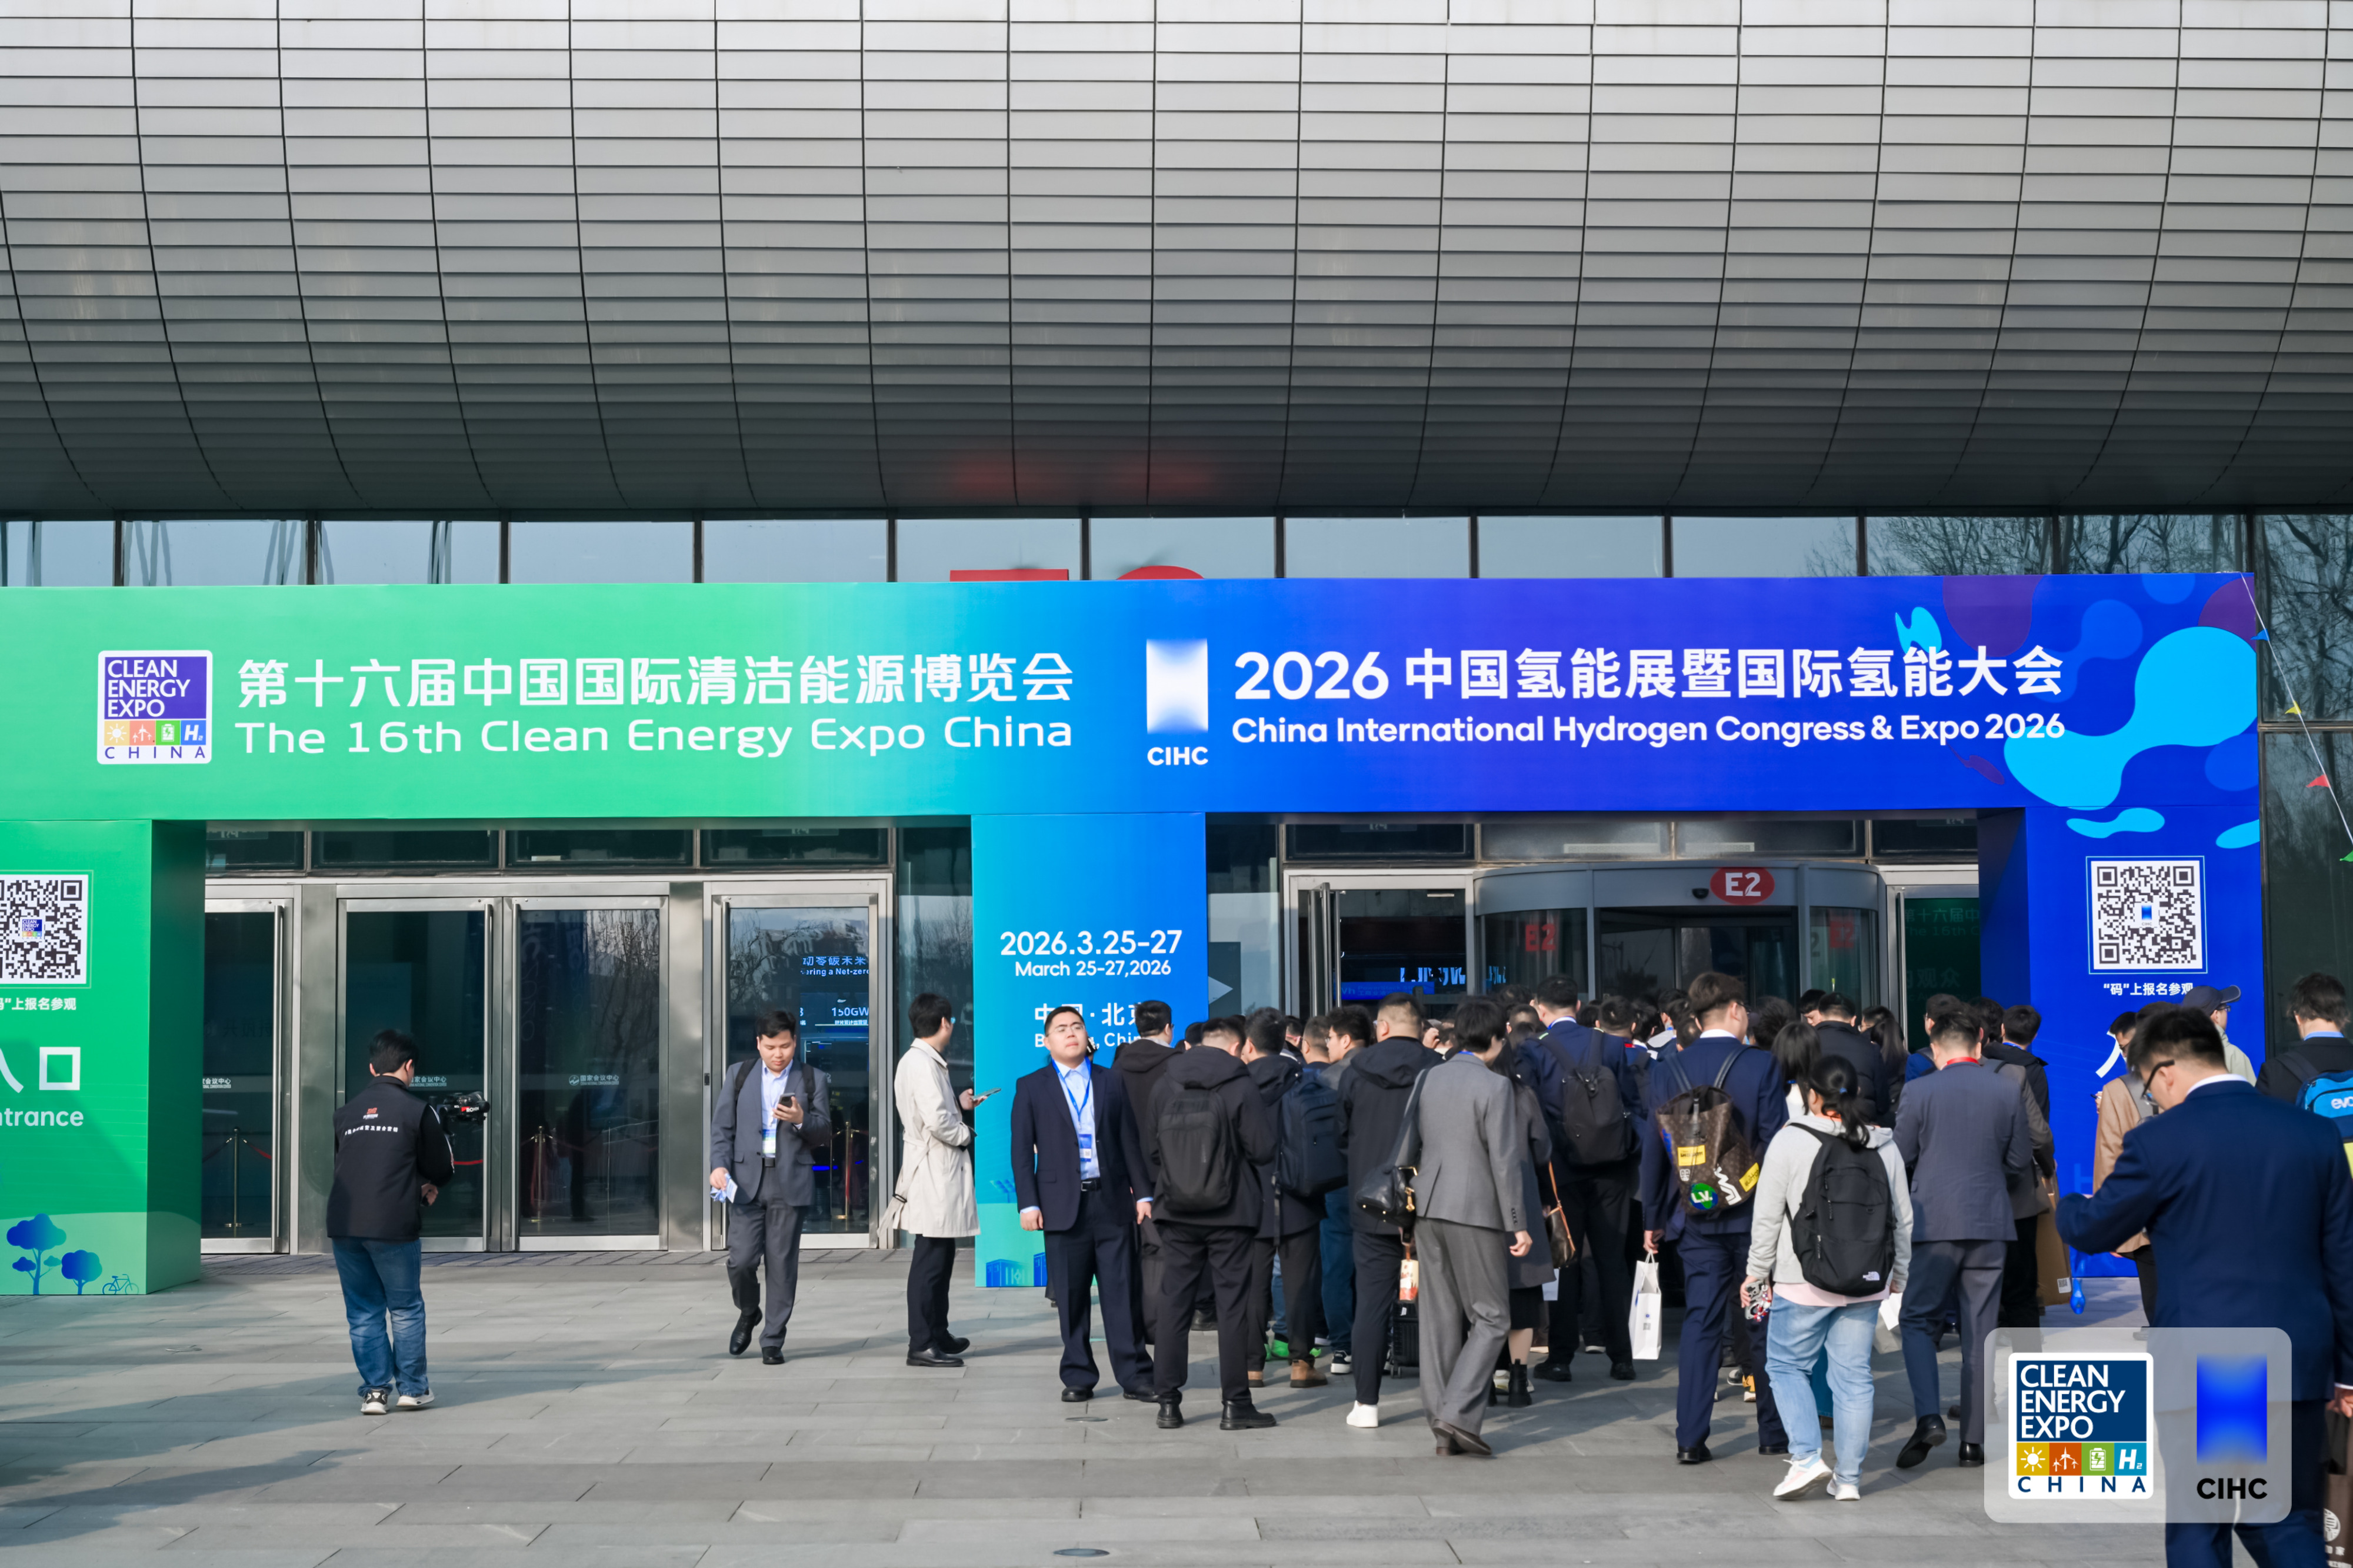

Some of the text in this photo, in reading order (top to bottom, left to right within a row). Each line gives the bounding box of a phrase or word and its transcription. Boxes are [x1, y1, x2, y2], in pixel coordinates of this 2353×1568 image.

[108, 659, 177, 678] CLEAN
[1235, 645, 2063, 700] 2026 中国氢能展暨国际氢能大会
[108, 679, 191, 698] ENERGY
[238, 653, 1072, 708] 第十六届中国国际清洁能源博览会
[108, 699, 165, 717] EXPO
[235, 716, 1071, 758] The 16th Clean Energy Expo China
[1232, 713, 2065, 748] China International Hydrogen Congress & Expo 2026
[105, 746, 205, 759] CHINA
[1147, 746, 1209, 766] CIHC
[1725, 872, 1761, 896] E2
[1001, 930, 1182, 955] 2026.3.25-27
[1526, 923, 1556, 950] E2
[1015, 960, 1171, 977] March 25-27,2026
[0, 1108, 84, 1126] trance
